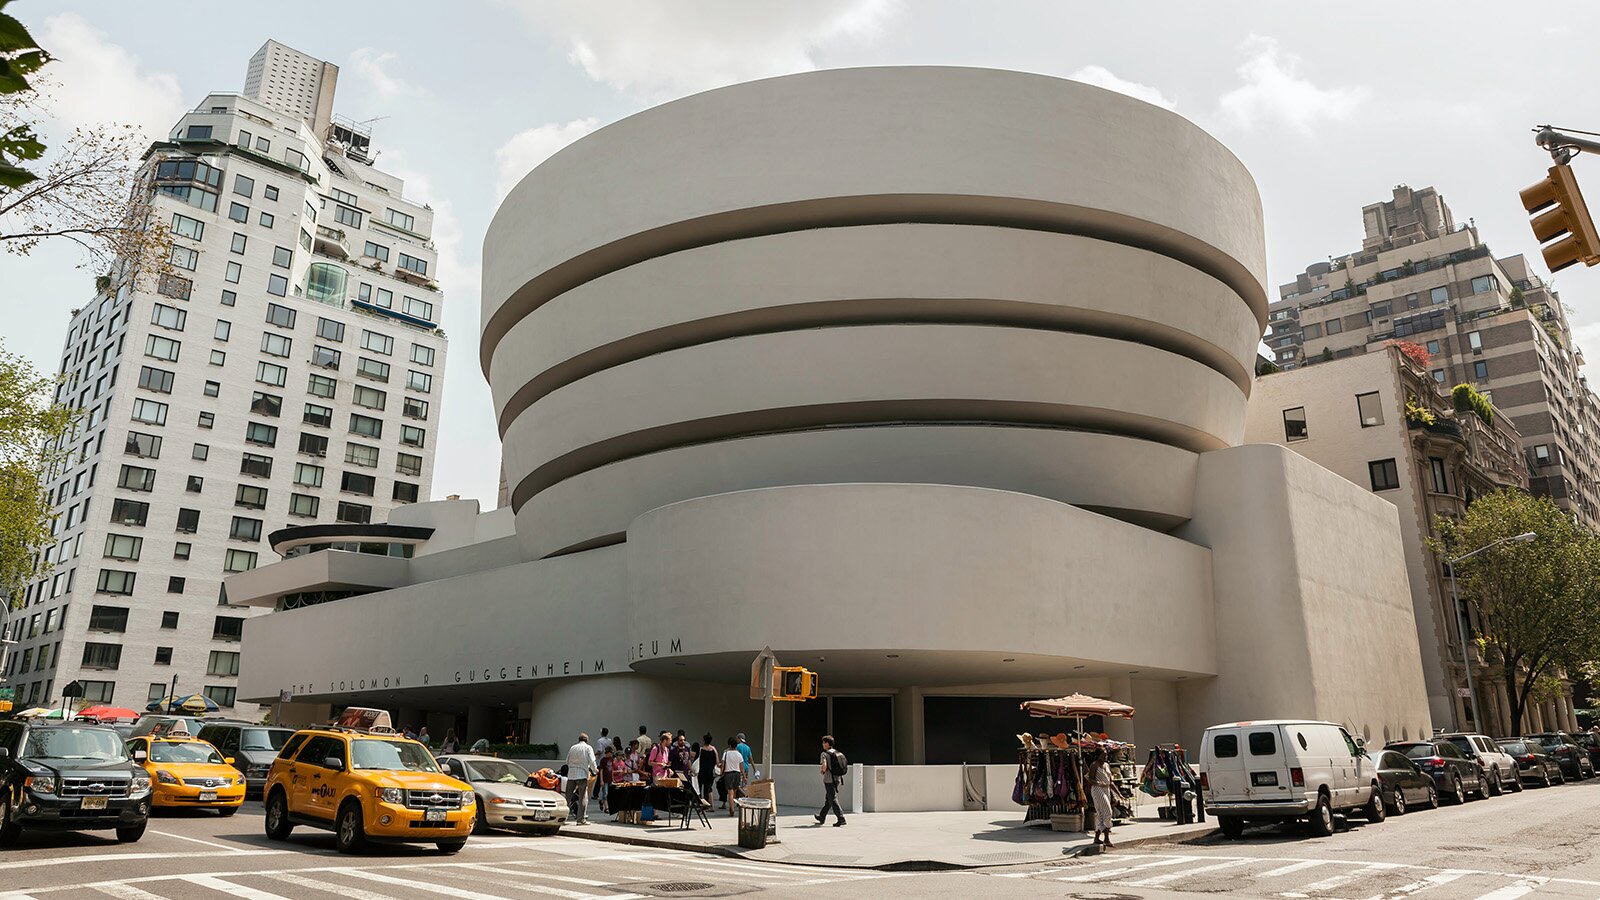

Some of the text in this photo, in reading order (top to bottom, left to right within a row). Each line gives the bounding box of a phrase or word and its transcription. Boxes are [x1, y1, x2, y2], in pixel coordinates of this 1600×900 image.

[293, 684, 313, 695] THE
[331, 677, 401, 692] SOLOMON
[424, 674, 429, 685] R
[455, 660, 605, 683] GUGGENHEIM
